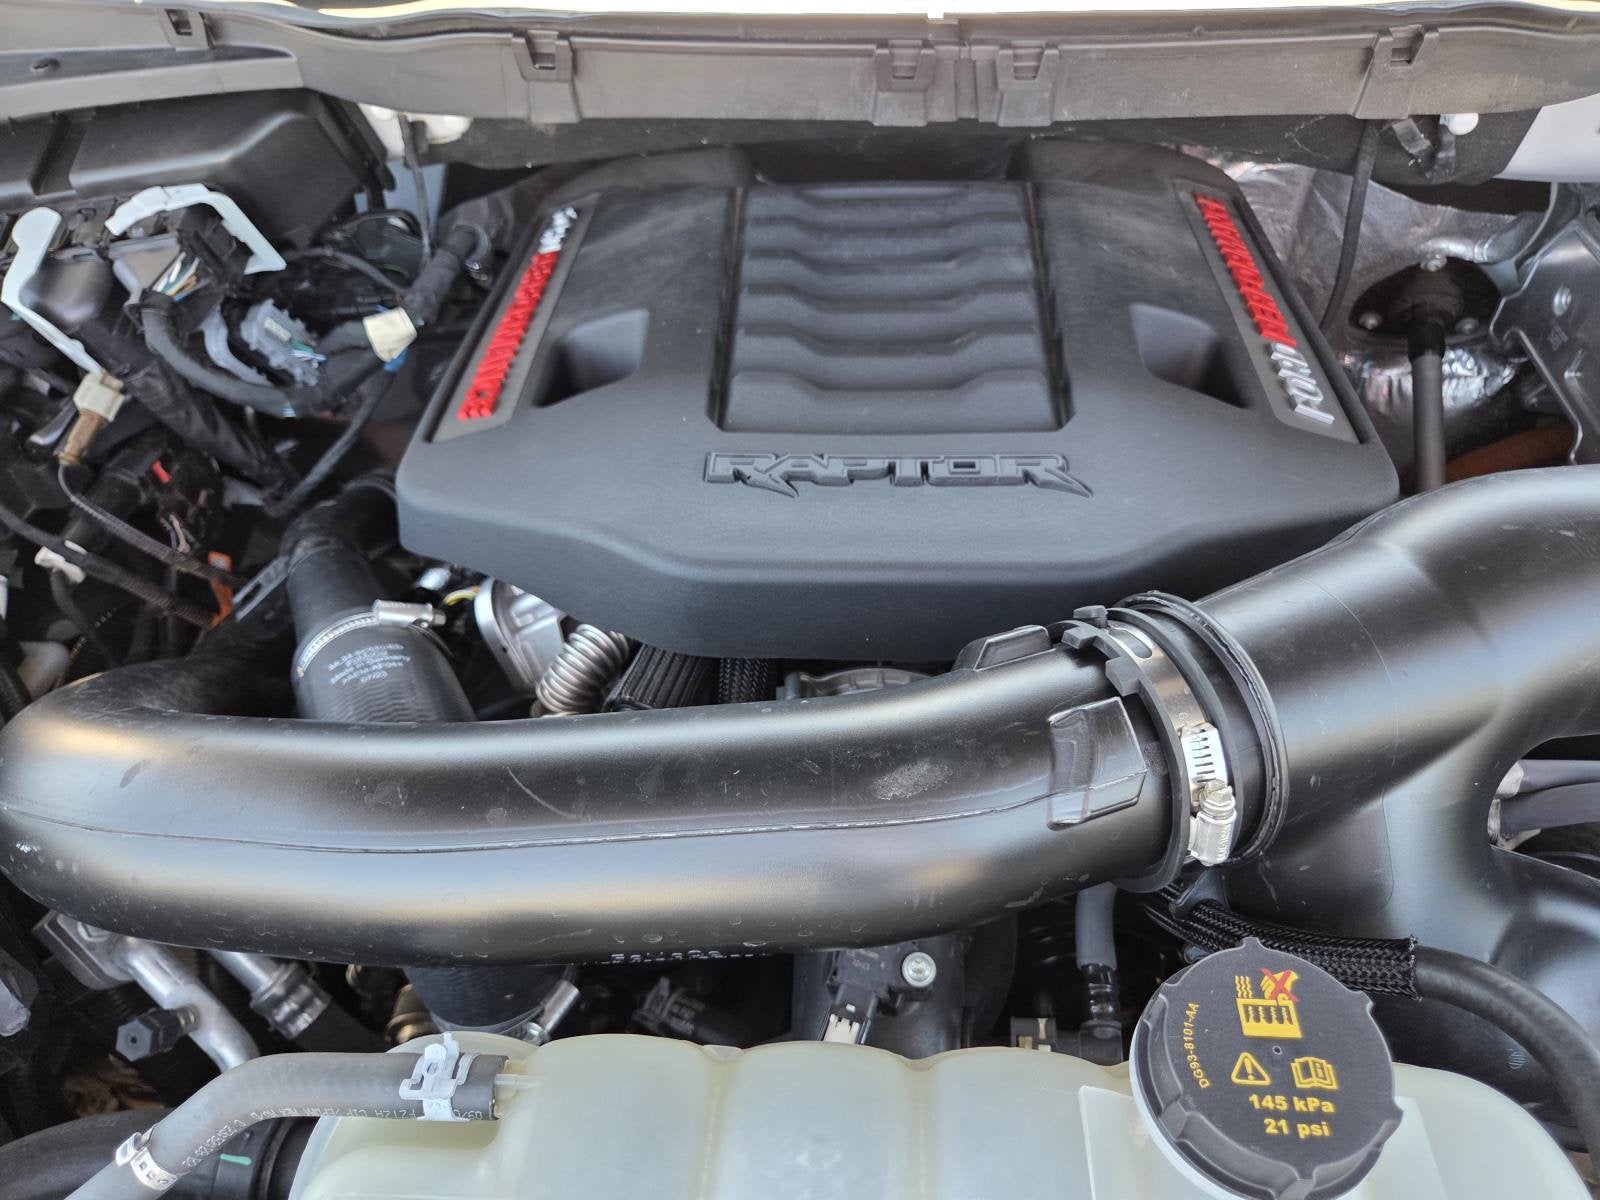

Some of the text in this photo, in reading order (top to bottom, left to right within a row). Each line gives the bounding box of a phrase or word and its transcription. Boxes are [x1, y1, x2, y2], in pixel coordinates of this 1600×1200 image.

[1270, 341, 1336, 424] FORD
[704, 452, 1094, 499] RAPTOR
[1182, 1002, 1211, 1089] DG93-8101-AA
[1249, 1093, 1336, 1113] 145 kPa
[1263, 1118, 1331, 1139] 21 psi
